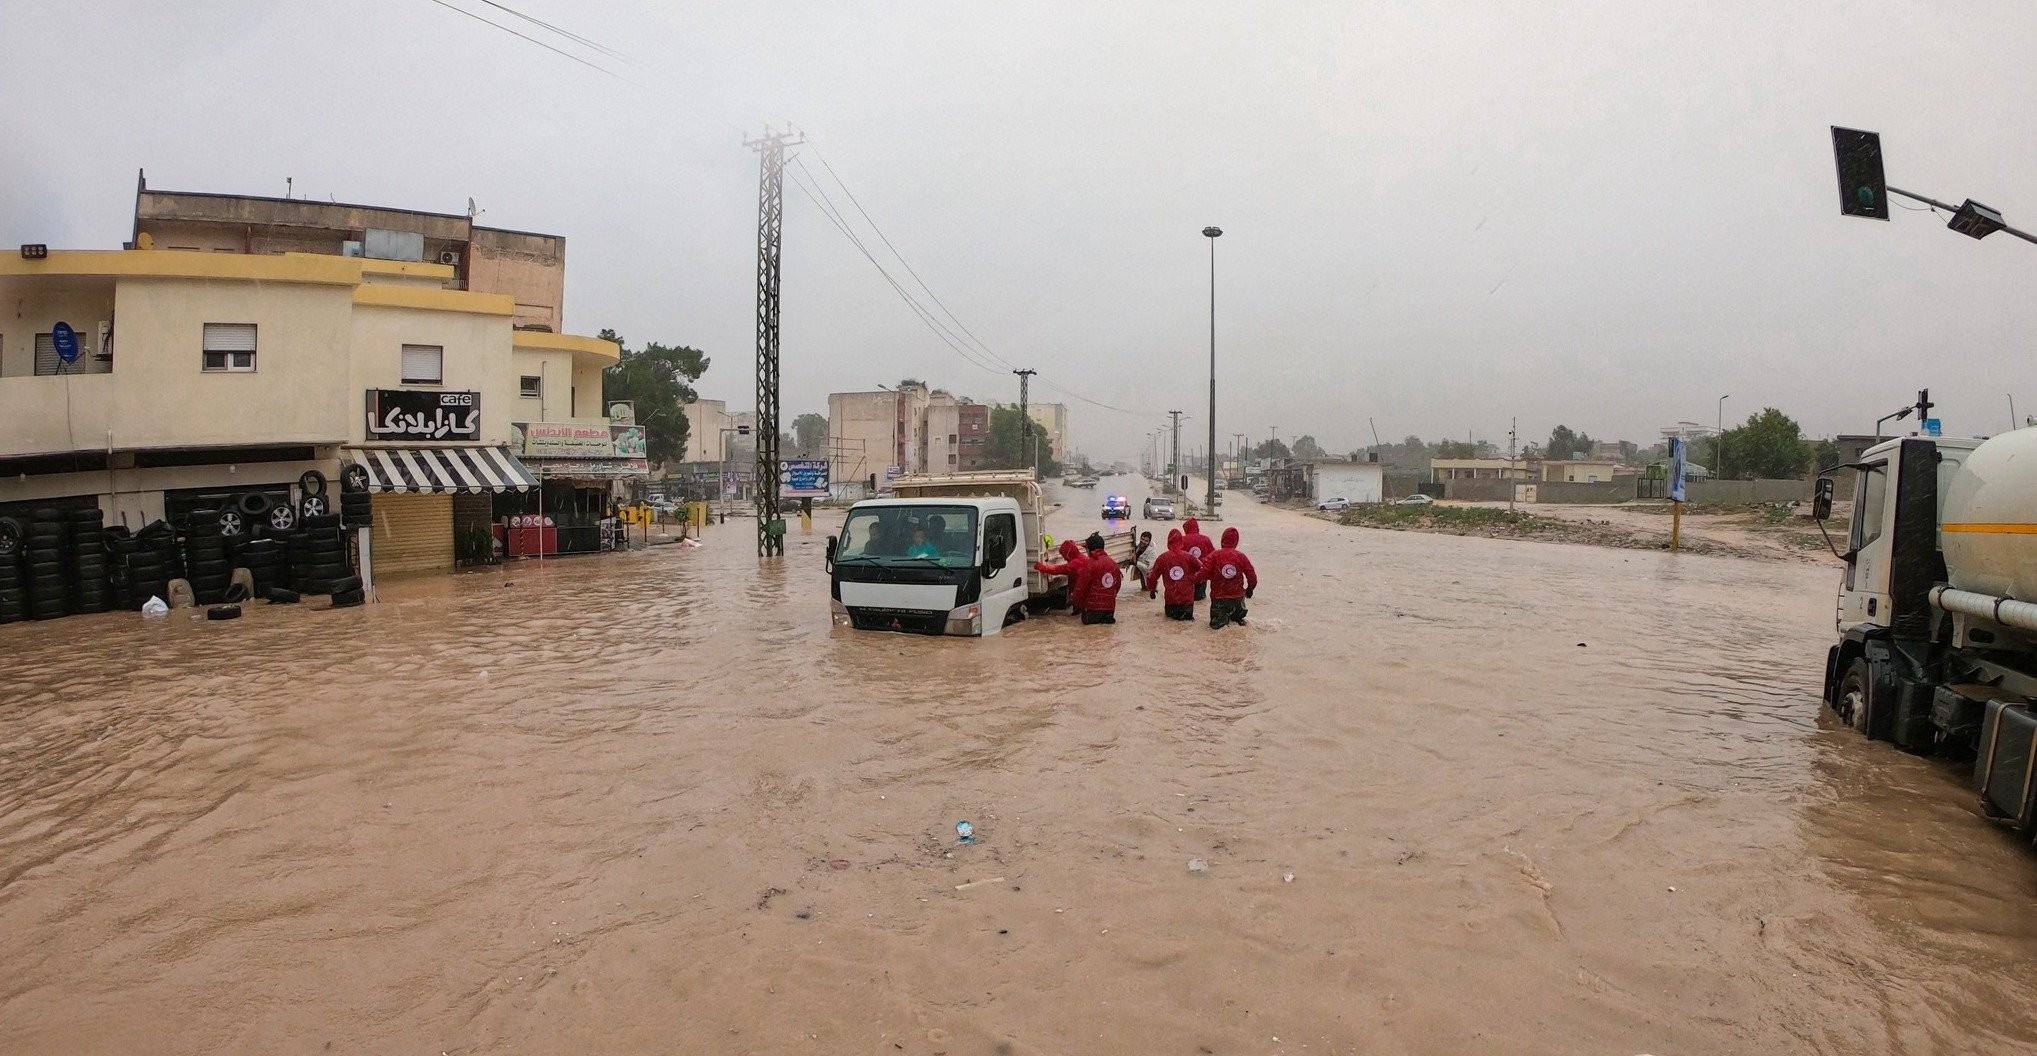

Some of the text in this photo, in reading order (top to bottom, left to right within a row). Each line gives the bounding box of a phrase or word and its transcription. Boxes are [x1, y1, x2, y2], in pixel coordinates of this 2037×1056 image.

[441, 394, 471, 404] cafe
[367, 406, 480, 439] كازابلانكا
[574, 428, 609, 439] مطعم
